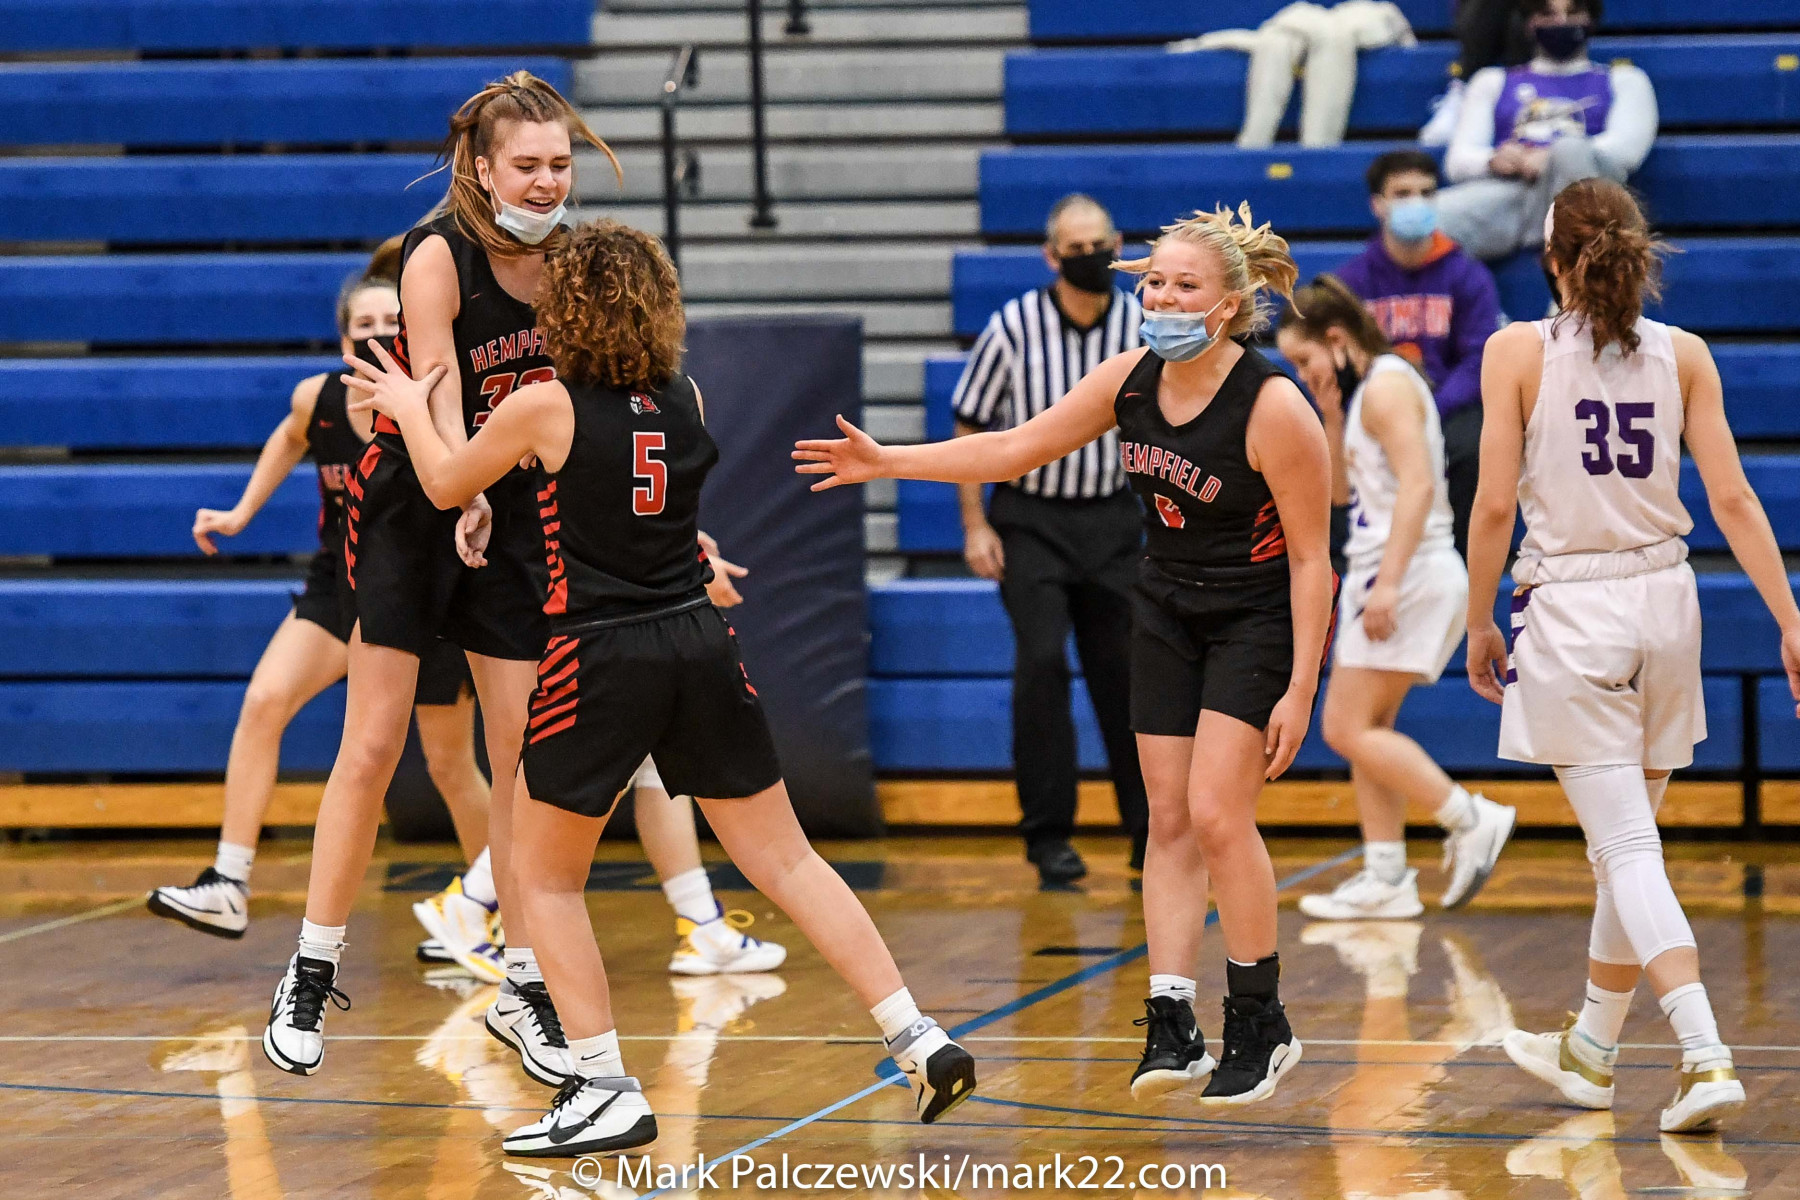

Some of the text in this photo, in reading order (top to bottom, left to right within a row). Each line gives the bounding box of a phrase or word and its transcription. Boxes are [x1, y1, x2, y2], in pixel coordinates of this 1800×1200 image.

[470, 328, 551, 373] HEMPFI
[632, 431, 668, 516] 5
[1575, 398, 1655, 479] 35
